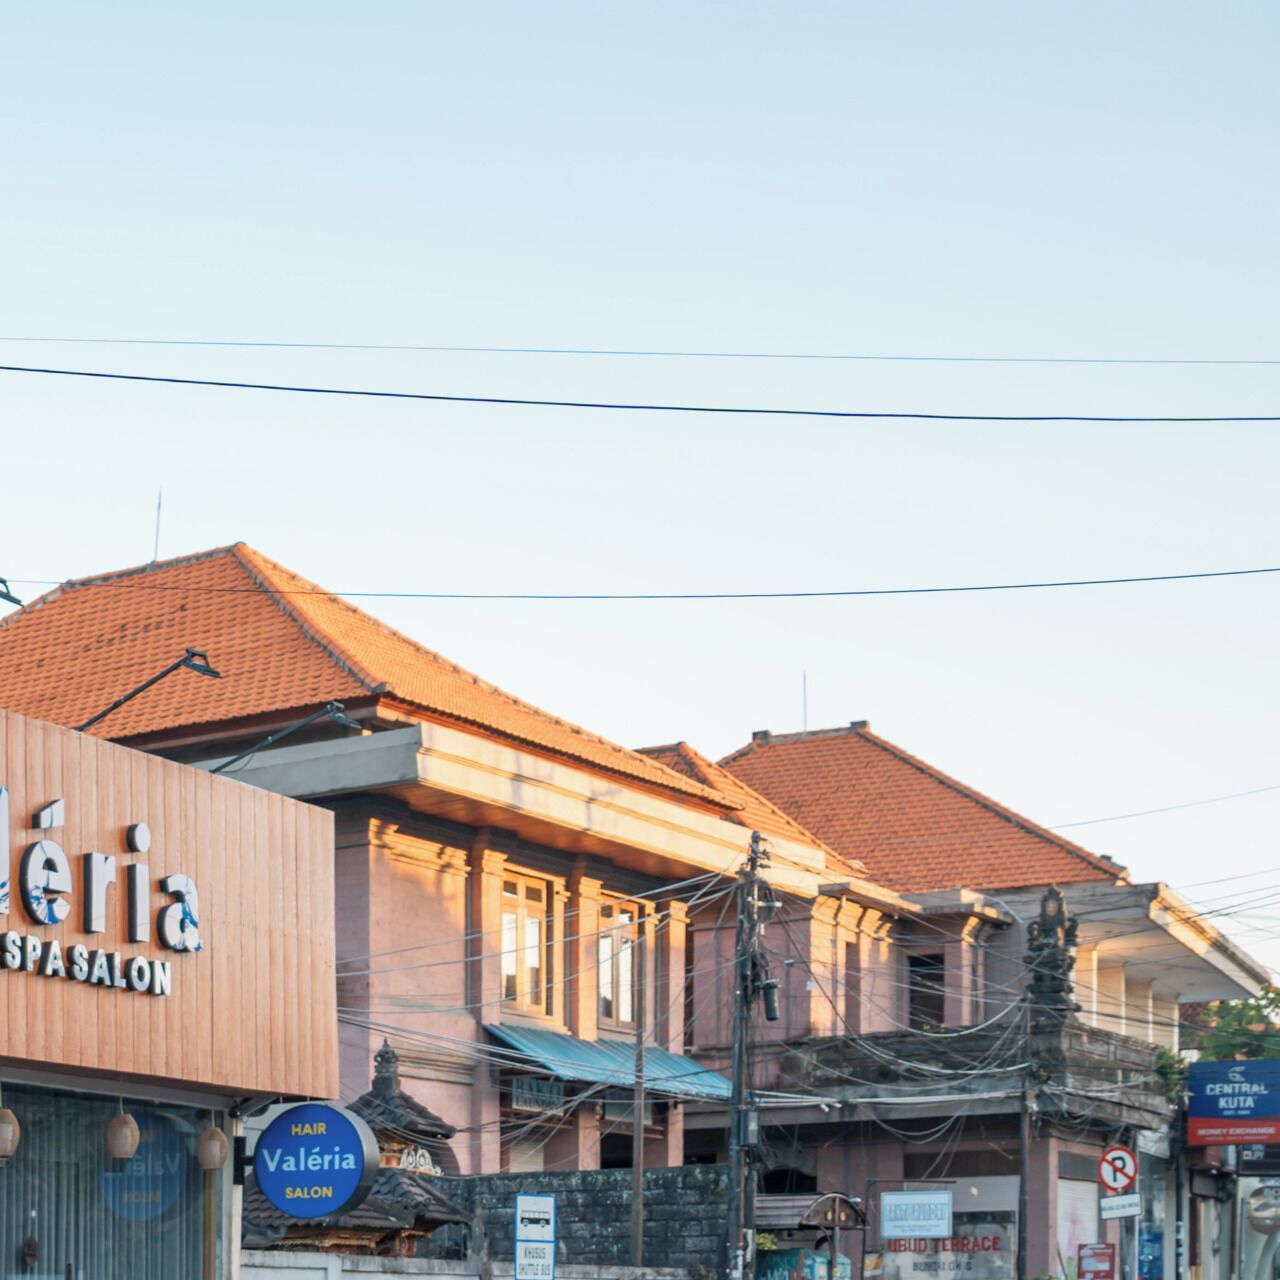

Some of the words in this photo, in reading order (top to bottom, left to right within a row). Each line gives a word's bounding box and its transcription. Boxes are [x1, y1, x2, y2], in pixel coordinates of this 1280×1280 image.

[1205, 1083, 1269, 1095] CENTRAL
[1218, 1096, 1255, 1109] KUTA
[291, 1122, 327, 1136] HAIR
[262, 1146, 357, 1172] Valéria
[285, 1186, 333, 1199] SALON
[886, 1238, 928, 1253] UBUD
[932, 1236, 1001, 1252] TERRACE
